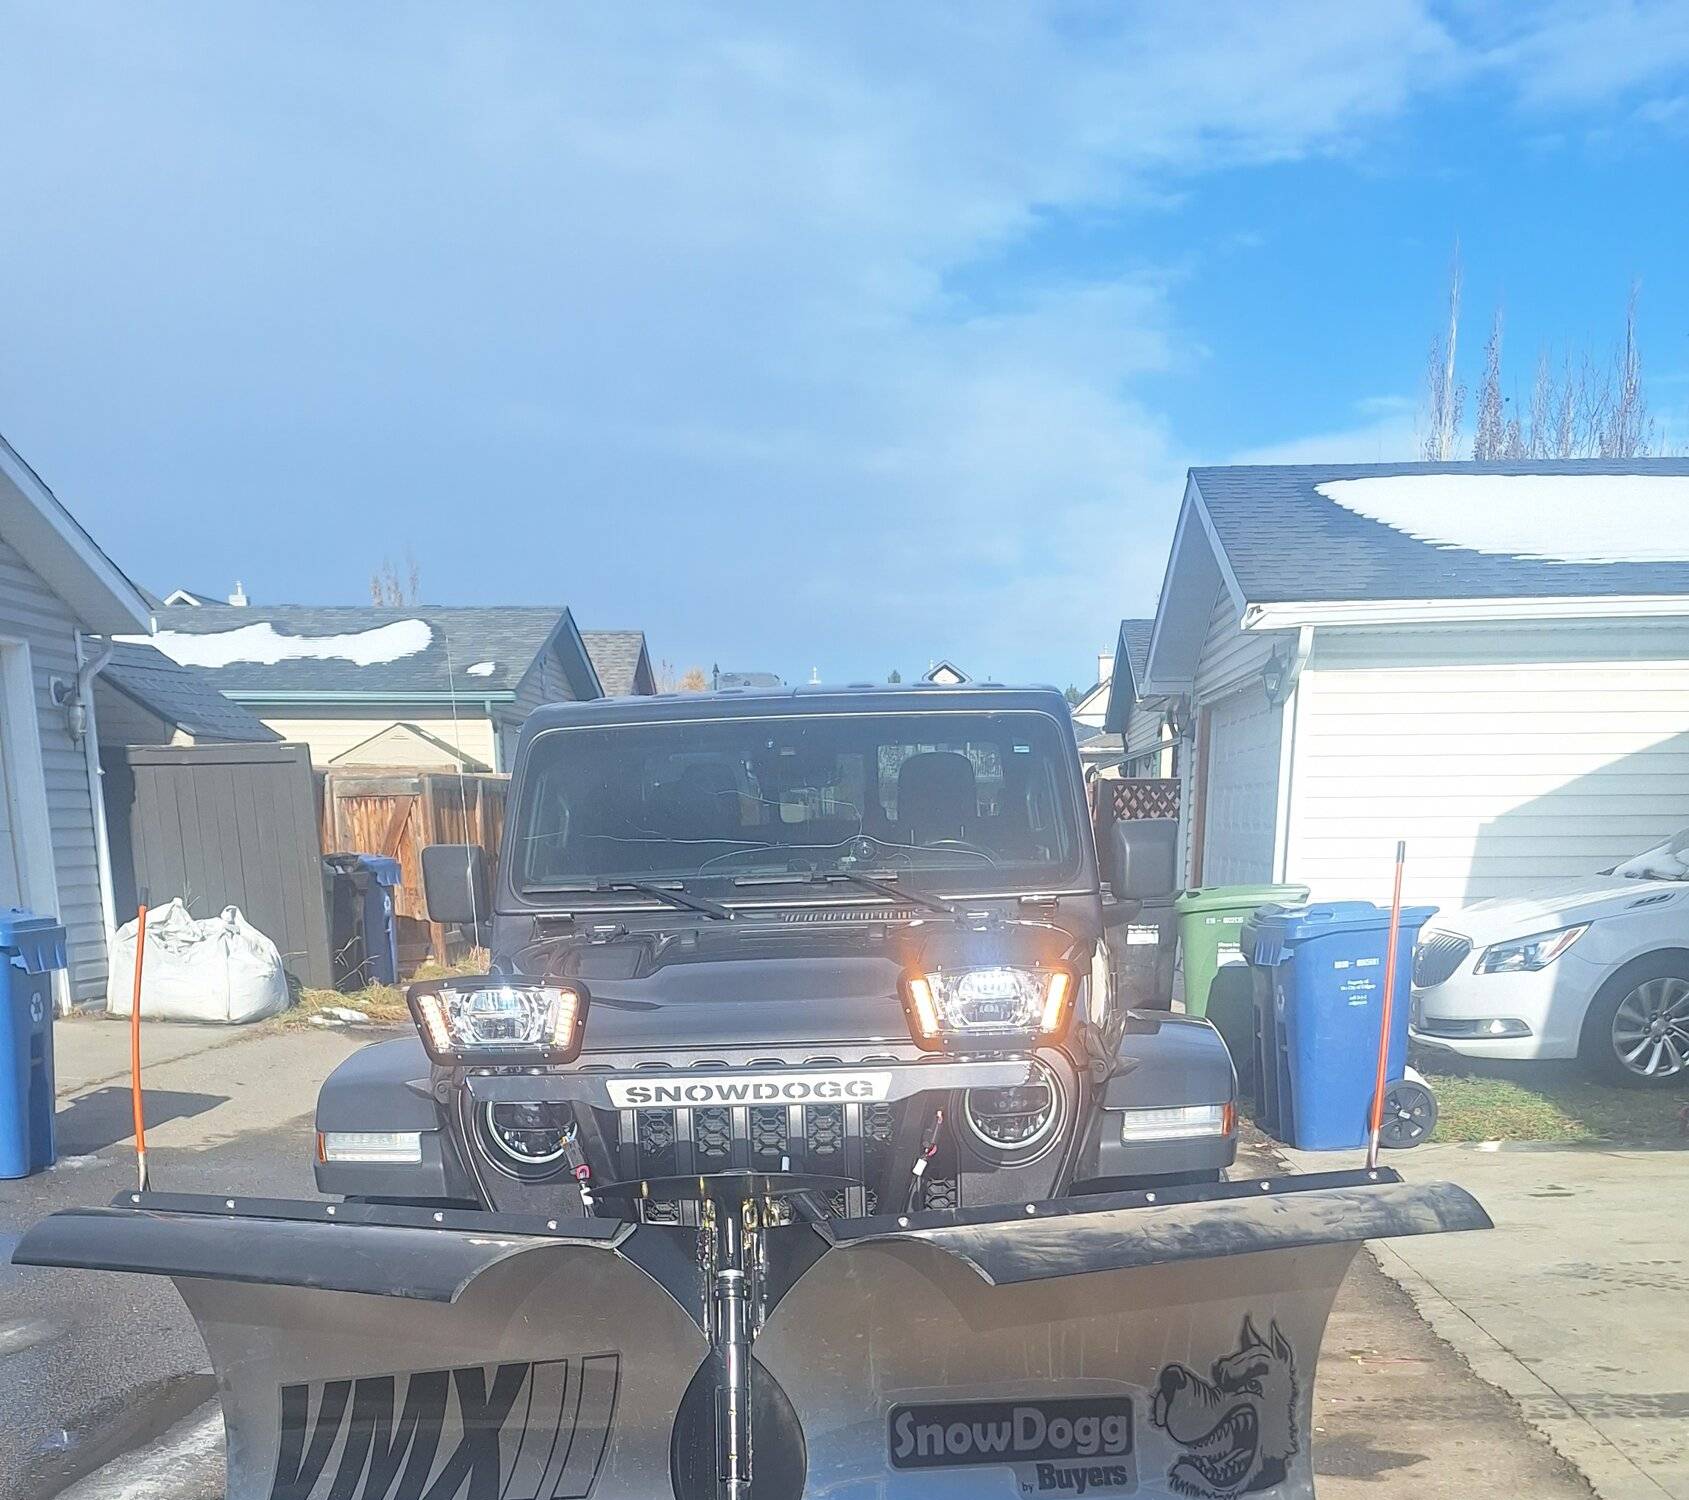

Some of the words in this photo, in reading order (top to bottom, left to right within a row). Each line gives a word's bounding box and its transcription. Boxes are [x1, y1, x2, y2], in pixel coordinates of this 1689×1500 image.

[625, 1080, 874, 1103] SNOWDOGG
[895, 1406, 1127, 1458] SnowDogg
[1021, 1482, 1034, 1494] by
[1036, 1463, 1128, 1494] Buyers
